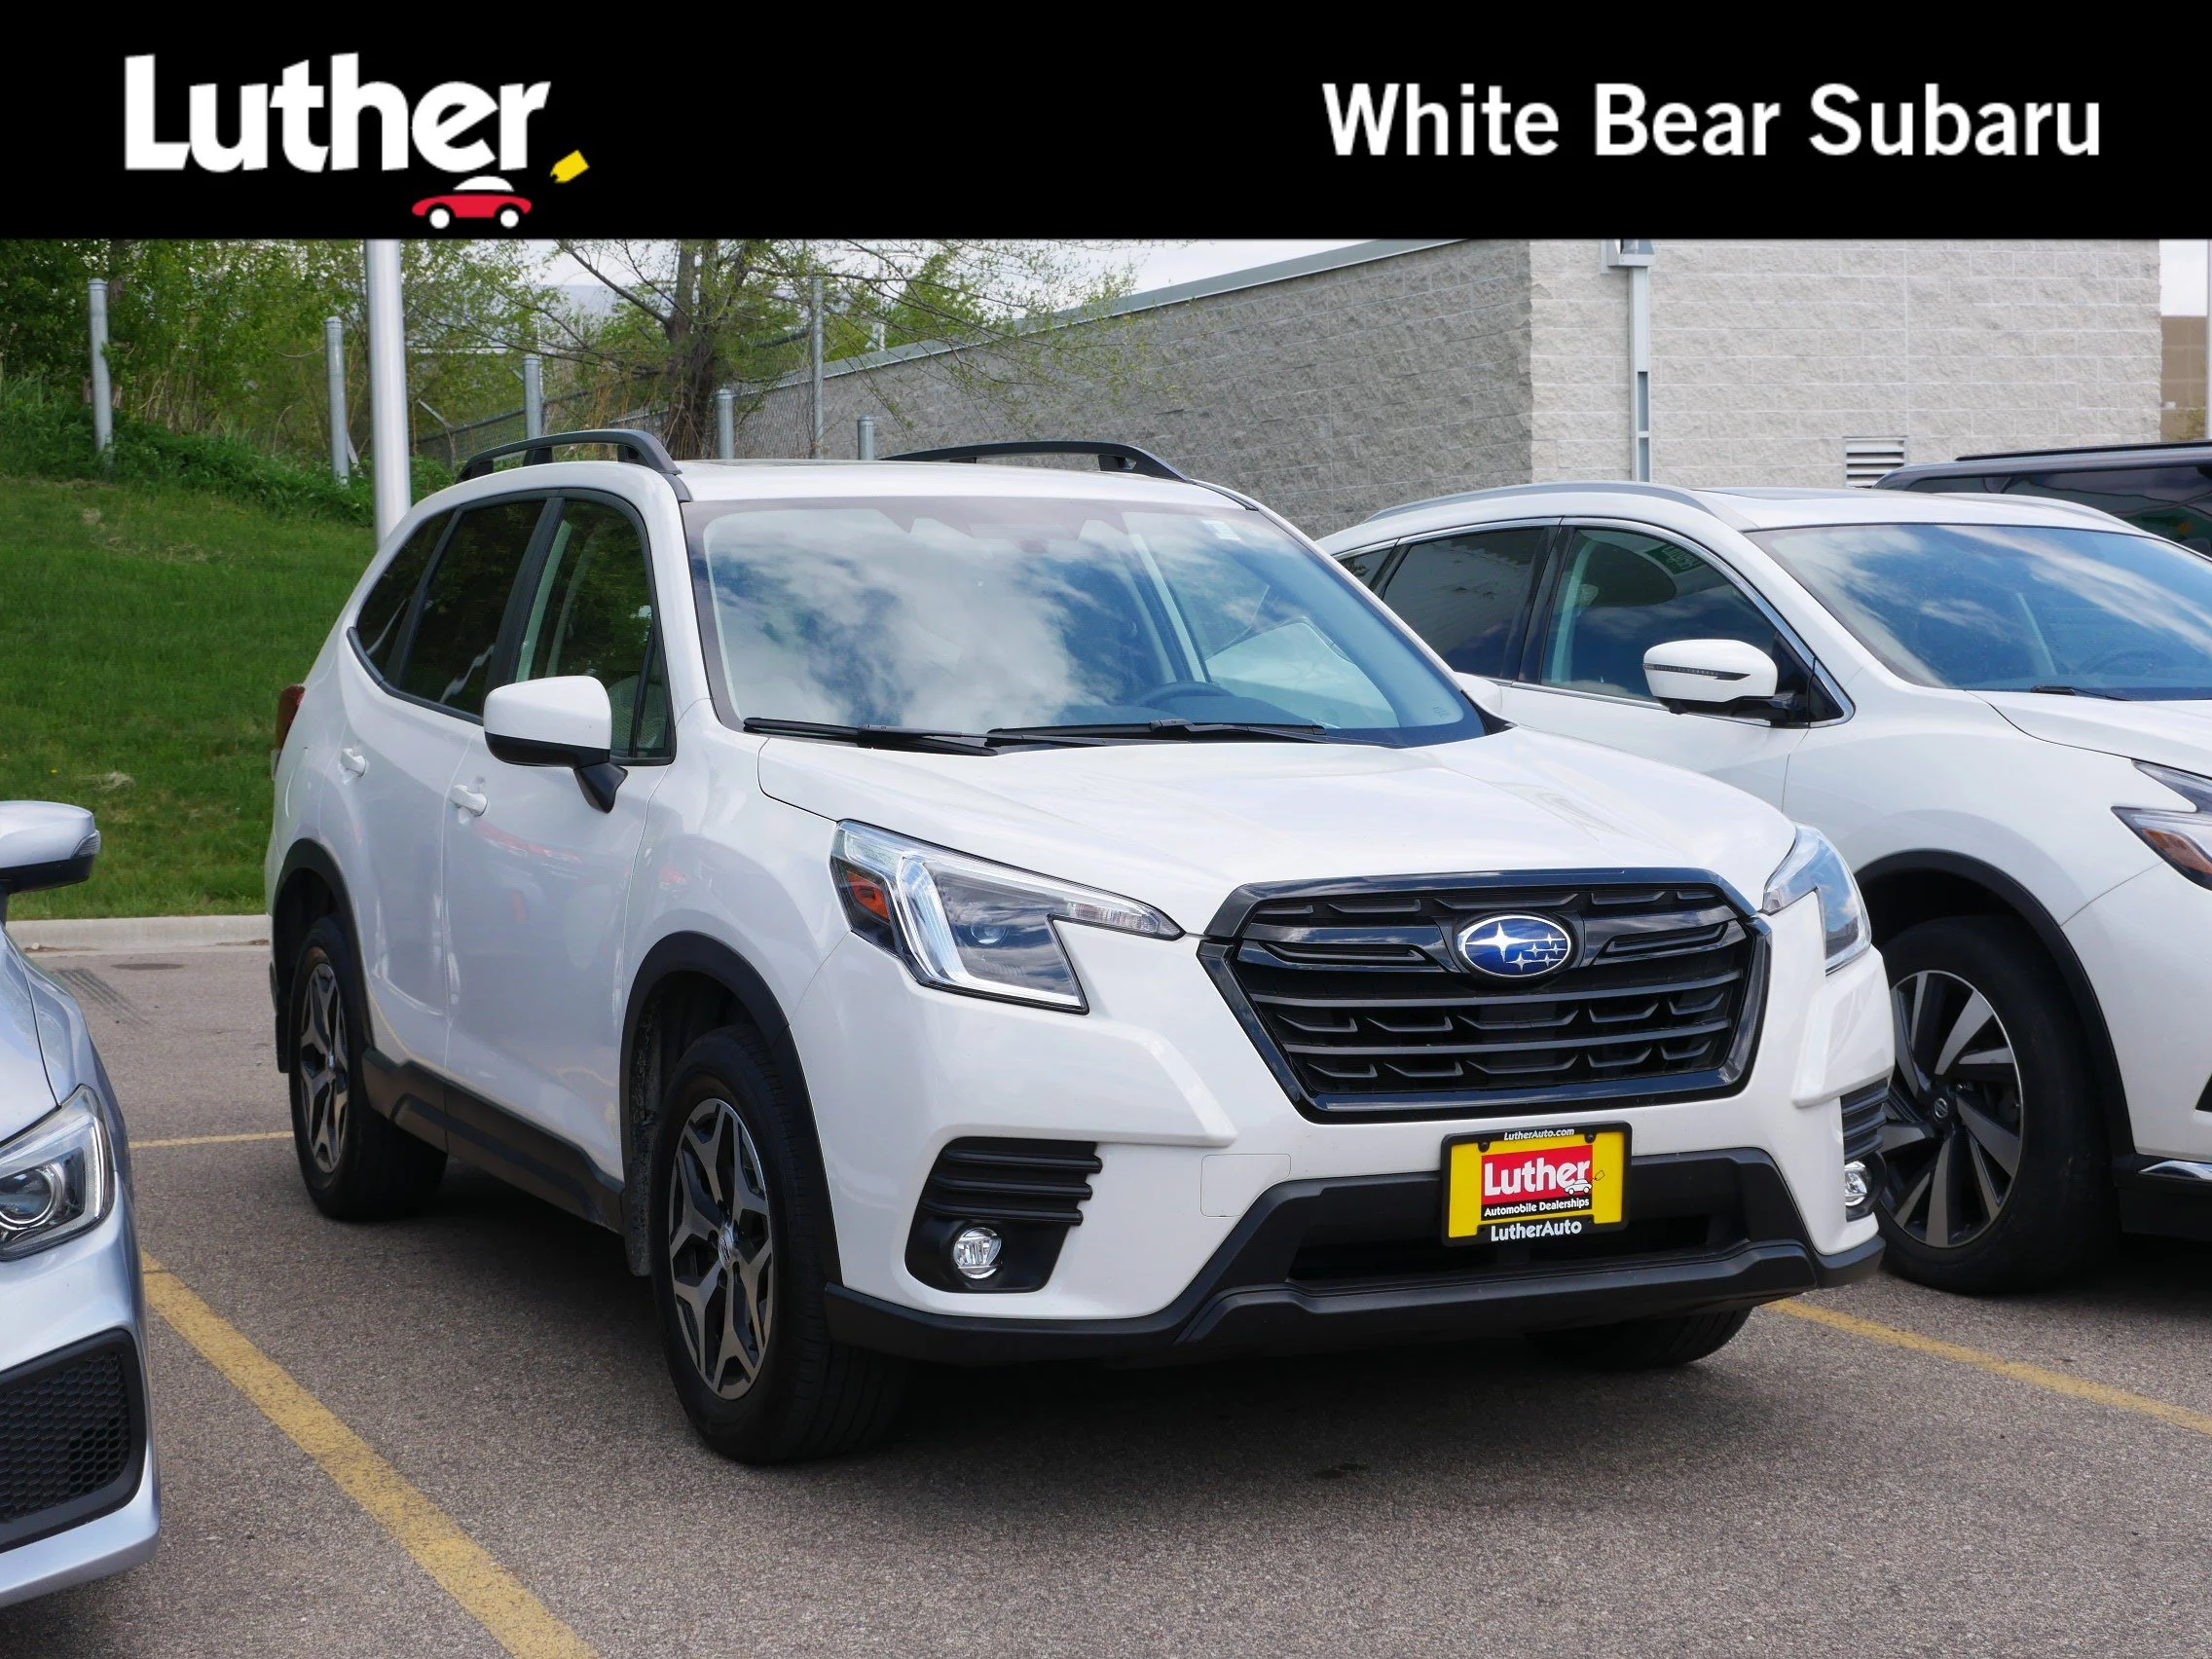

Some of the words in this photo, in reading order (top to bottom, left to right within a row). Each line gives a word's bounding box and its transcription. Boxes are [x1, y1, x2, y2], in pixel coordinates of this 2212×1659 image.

[1503, 1128, 1574, 1141] LutherAuto.com
[1484, 1157, 1591, 1197] Luther
[1484, 1203, 1537, 1217] Automobile
[1538, 1198, 1590, 1211] Dealerships
[1491, 1218, 1583, 1242] LutherAuto
